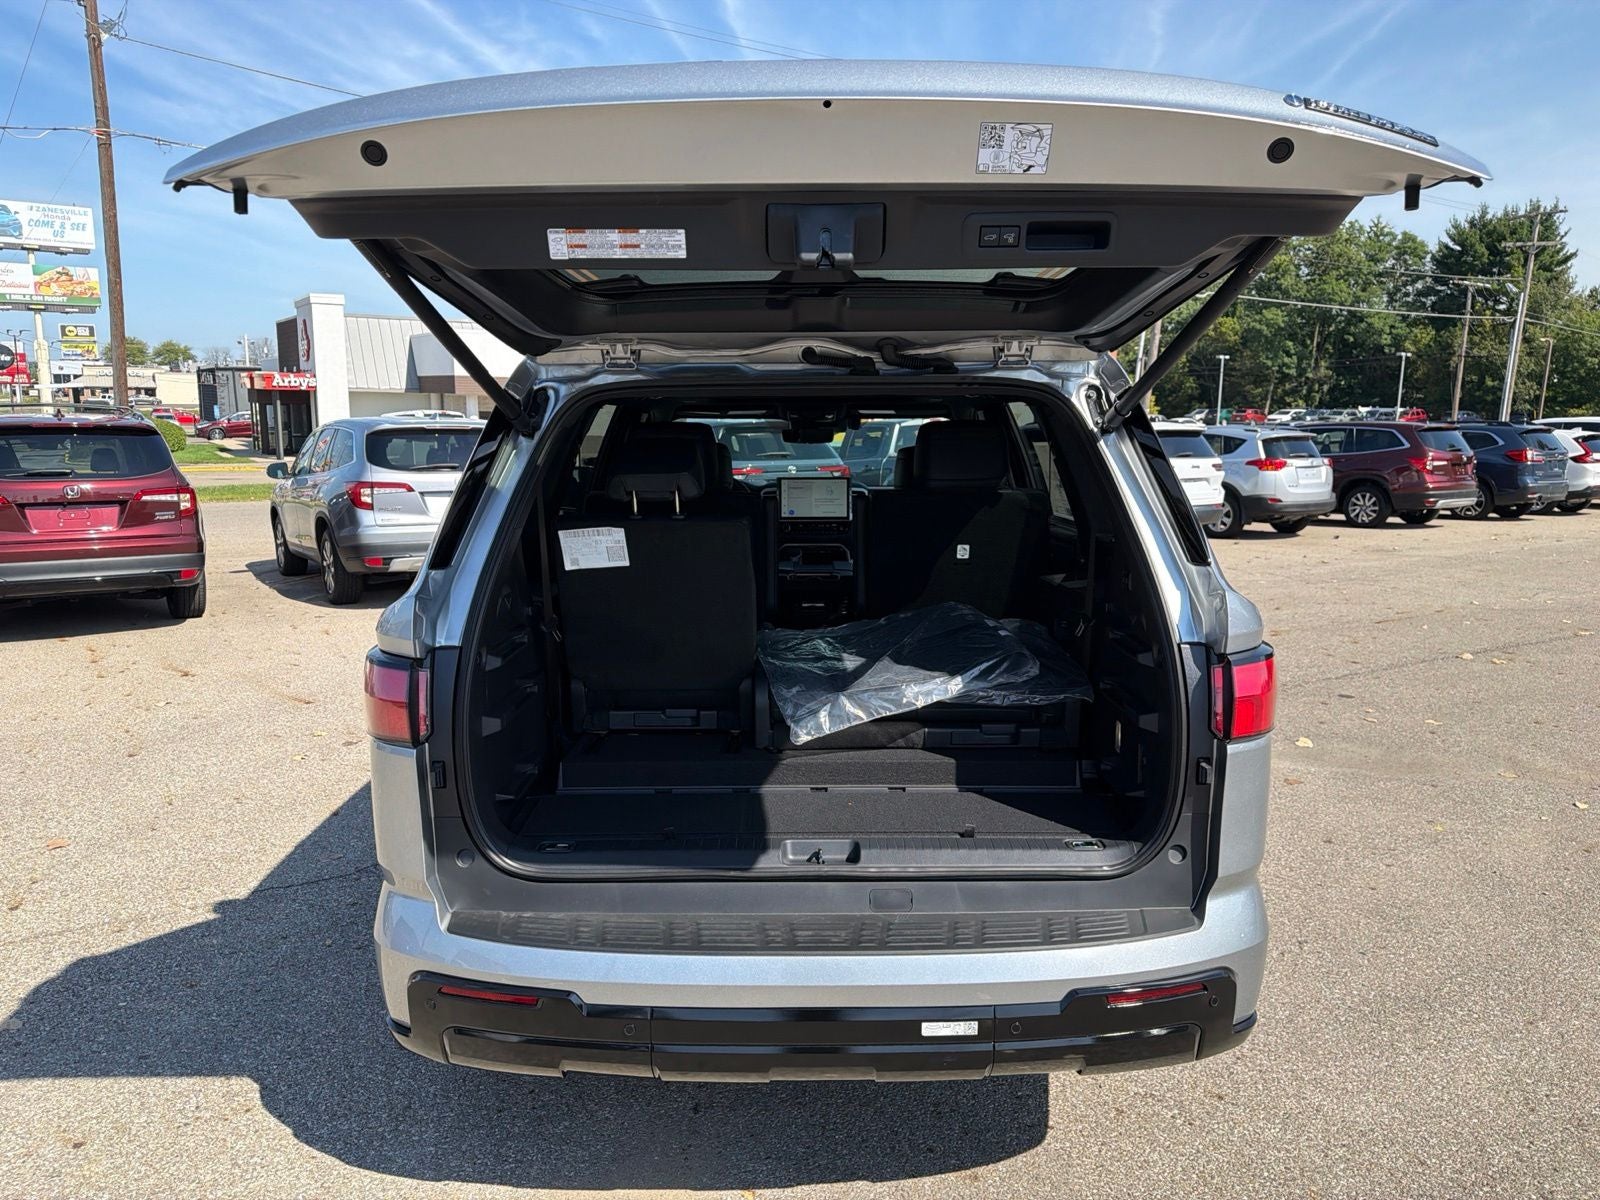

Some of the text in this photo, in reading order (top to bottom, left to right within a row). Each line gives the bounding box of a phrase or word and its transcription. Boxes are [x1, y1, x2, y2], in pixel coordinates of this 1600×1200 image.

[28, 218, 87, 231] COME & SEE
[53, 229, 65, 238] US
[272, 373, 317, 390] Arby's
